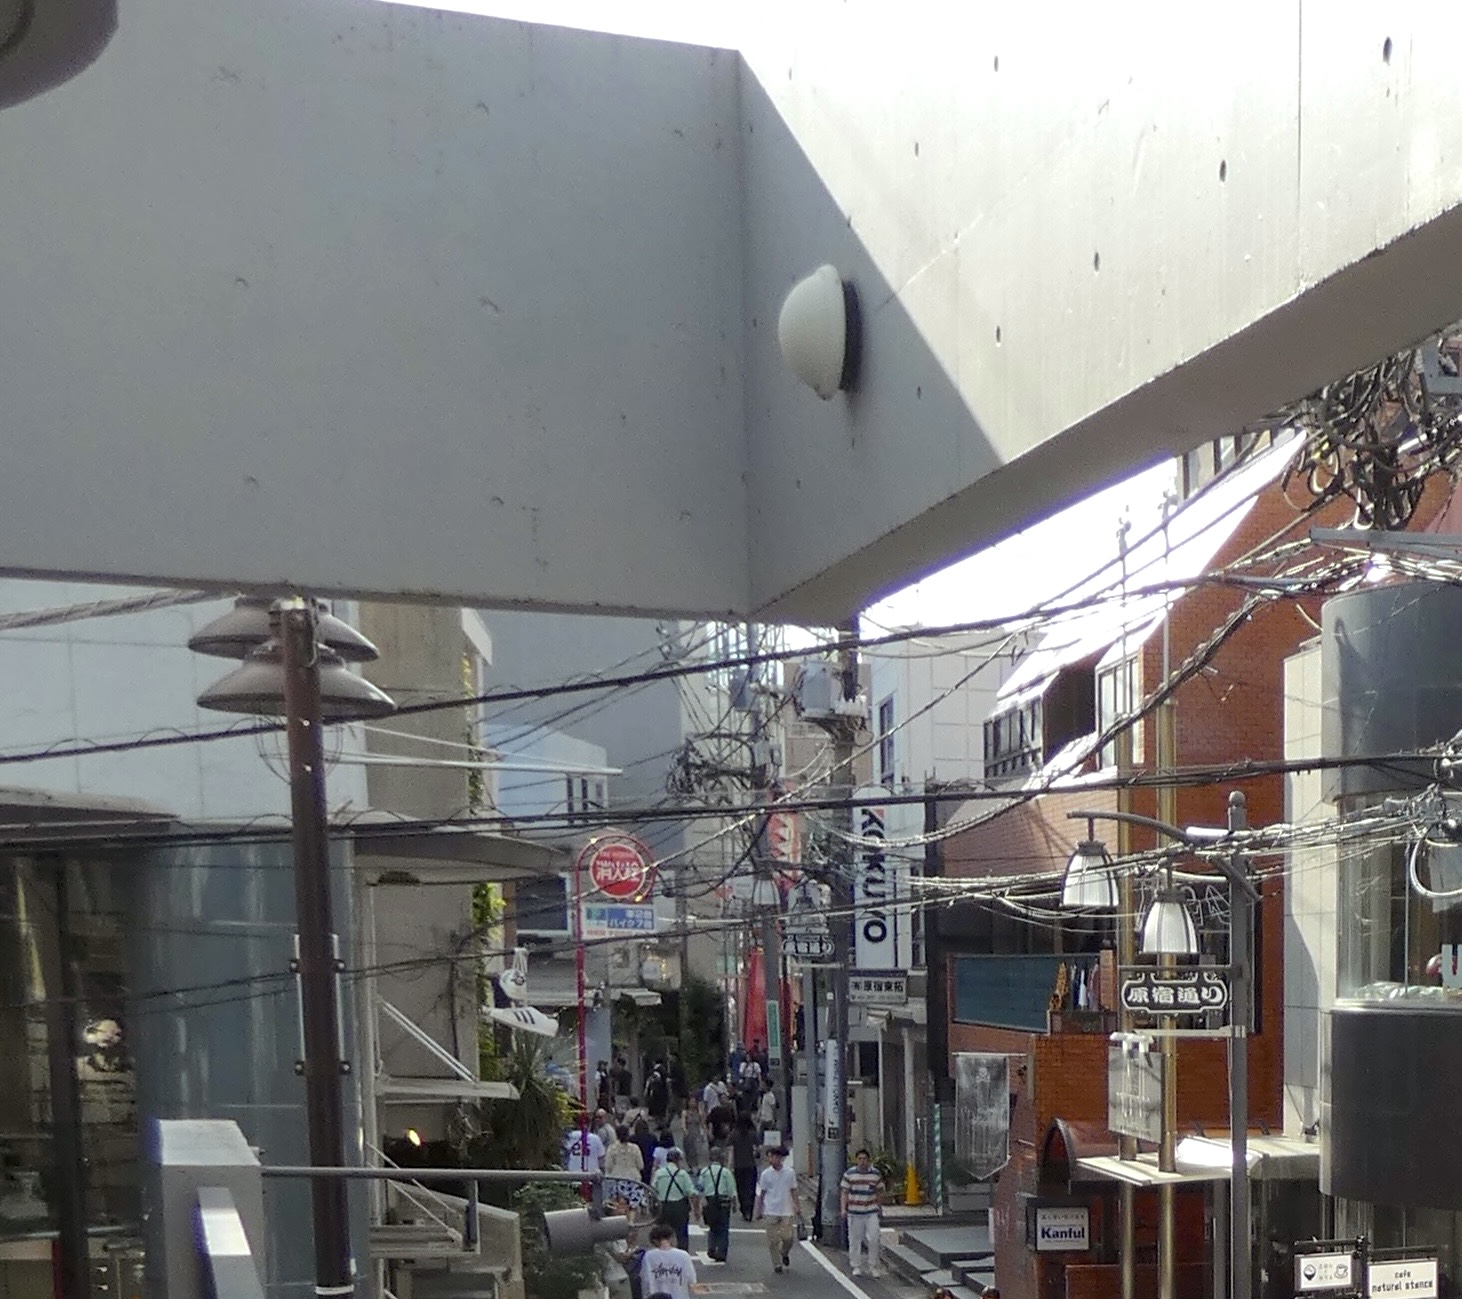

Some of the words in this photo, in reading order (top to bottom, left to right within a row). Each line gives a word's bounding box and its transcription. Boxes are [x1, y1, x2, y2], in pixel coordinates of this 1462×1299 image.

[1127, 985, 1222, 1005] 原宿通り
[1041, 1227, 1085, 1239] Kanful
[1371, 1282, 1403, 1293] natural
[1405, 1279, 1434, 1290] stance
